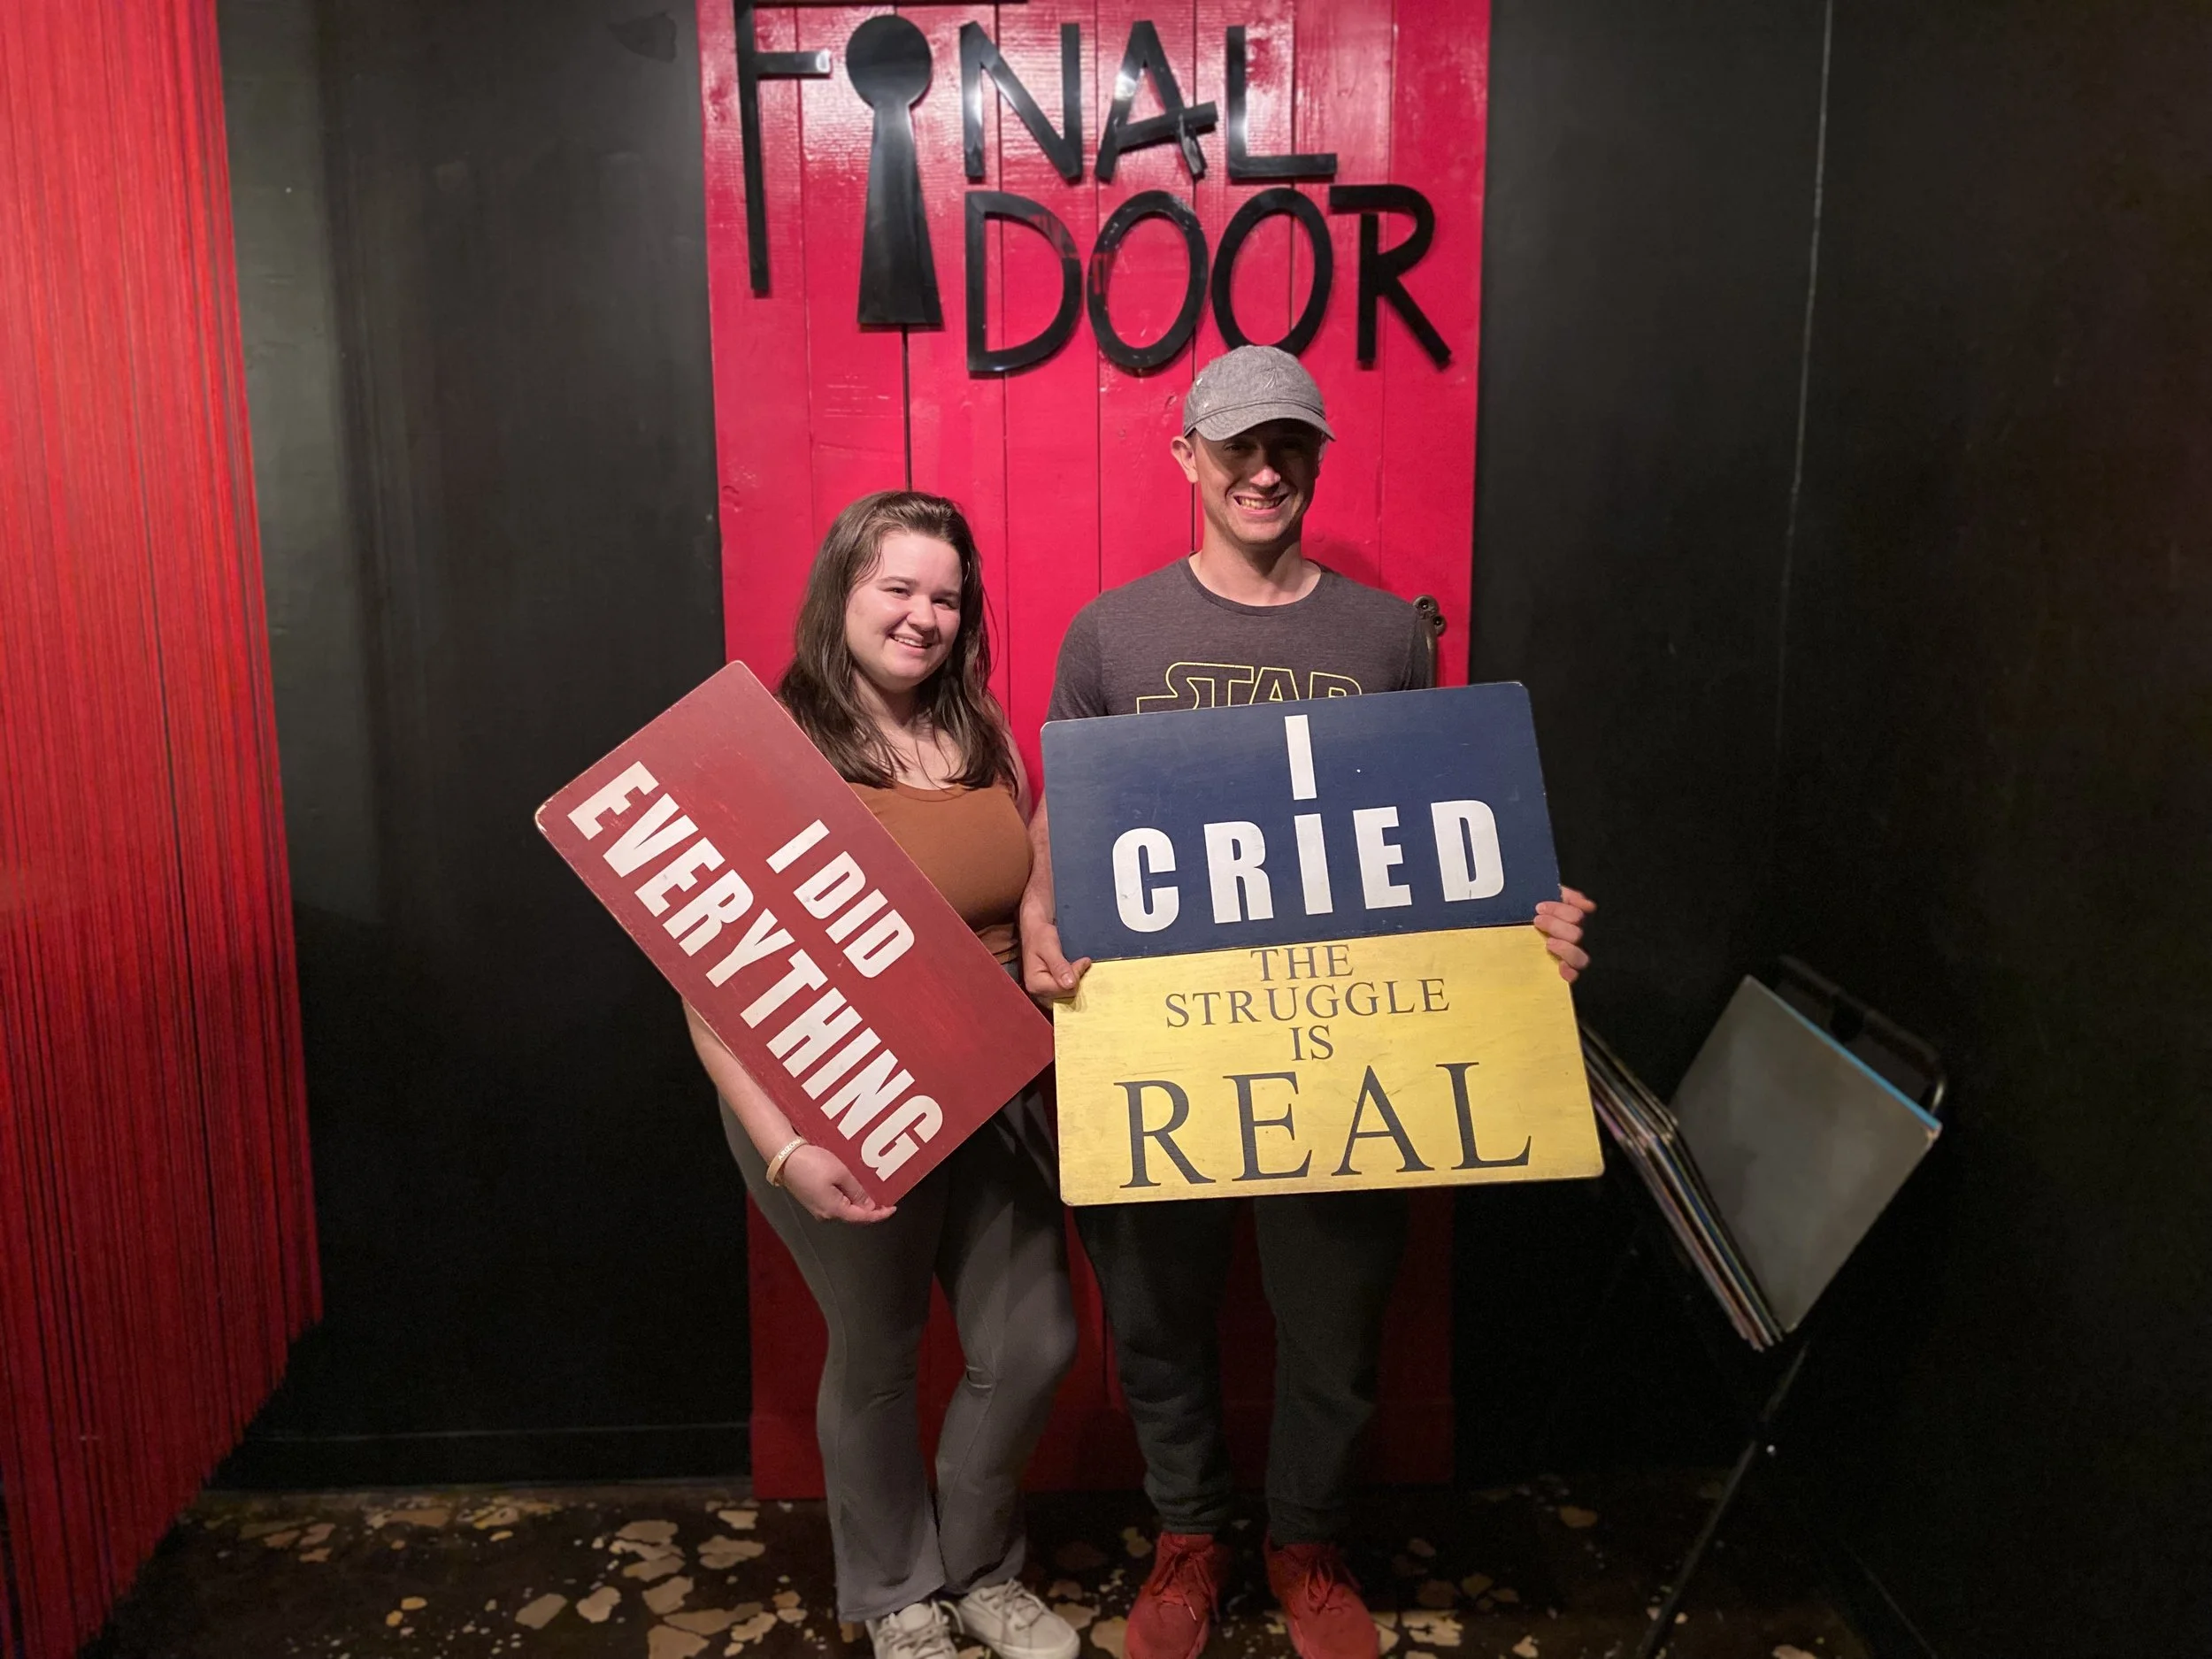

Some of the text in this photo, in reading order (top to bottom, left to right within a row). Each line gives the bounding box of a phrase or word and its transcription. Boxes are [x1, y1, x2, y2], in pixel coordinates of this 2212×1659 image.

[964, 184, 1451, 373] DOOR
[1285, 715, 1317, 800] I
[765, 819, 915, 978] I DID
[1112, 800, 1505, 932] CRIED
[568, 761, 943, 1181] EVERYTHING
[1167, 979, 1450, 1028] STRUGGLE
[1251, 944, 1354, 981] THE
[1291, 1025, 1333, 1061] IS
[1114, 1062, 1532, 1188] REAL
